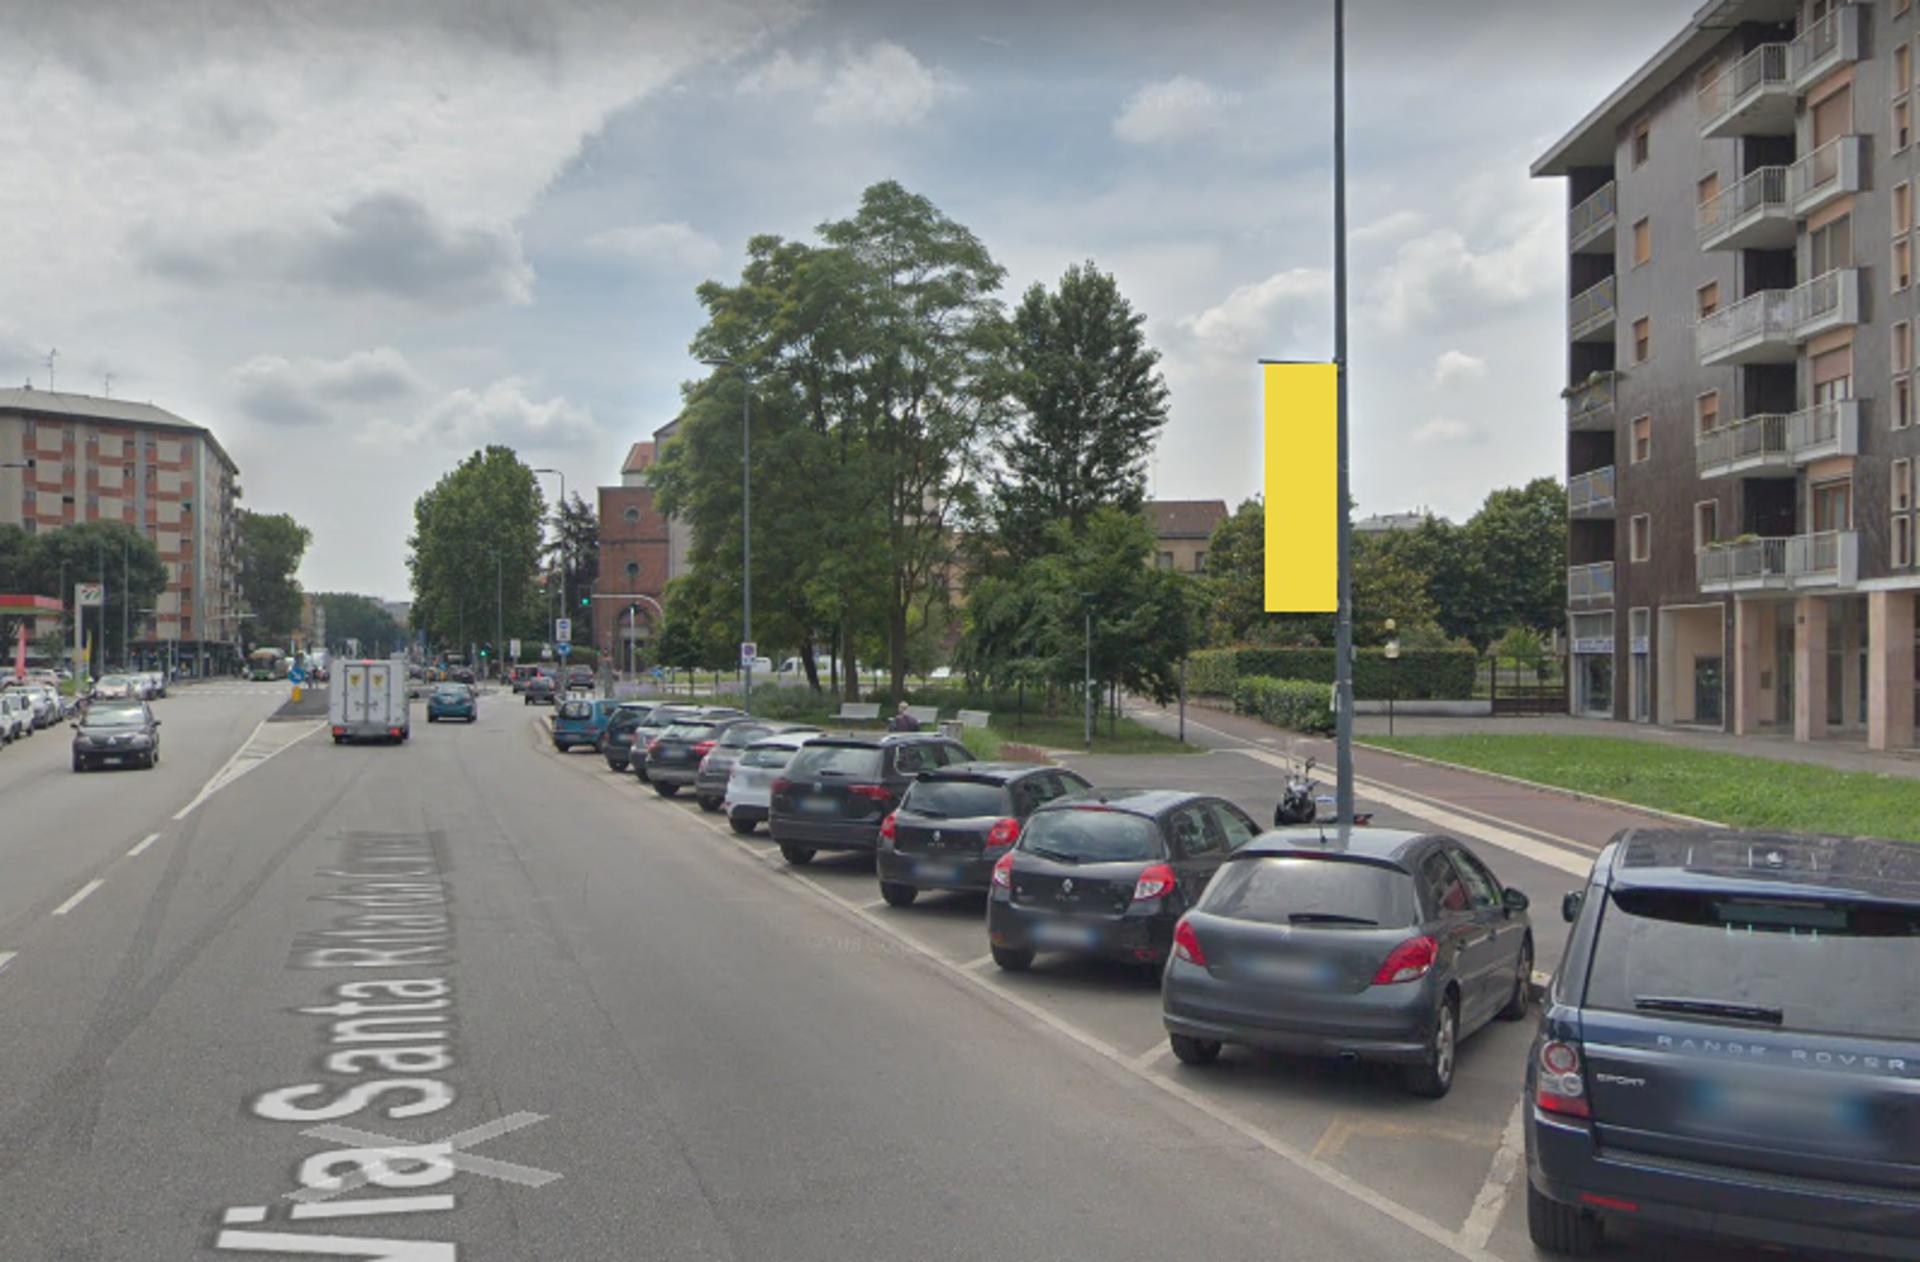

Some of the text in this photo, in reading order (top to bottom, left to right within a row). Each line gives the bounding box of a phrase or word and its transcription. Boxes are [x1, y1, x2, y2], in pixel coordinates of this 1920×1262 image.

[1656, 1035, 1905, 1072] RANGE ROVER
[1596, 1073, 1647, 1087] SPORT
